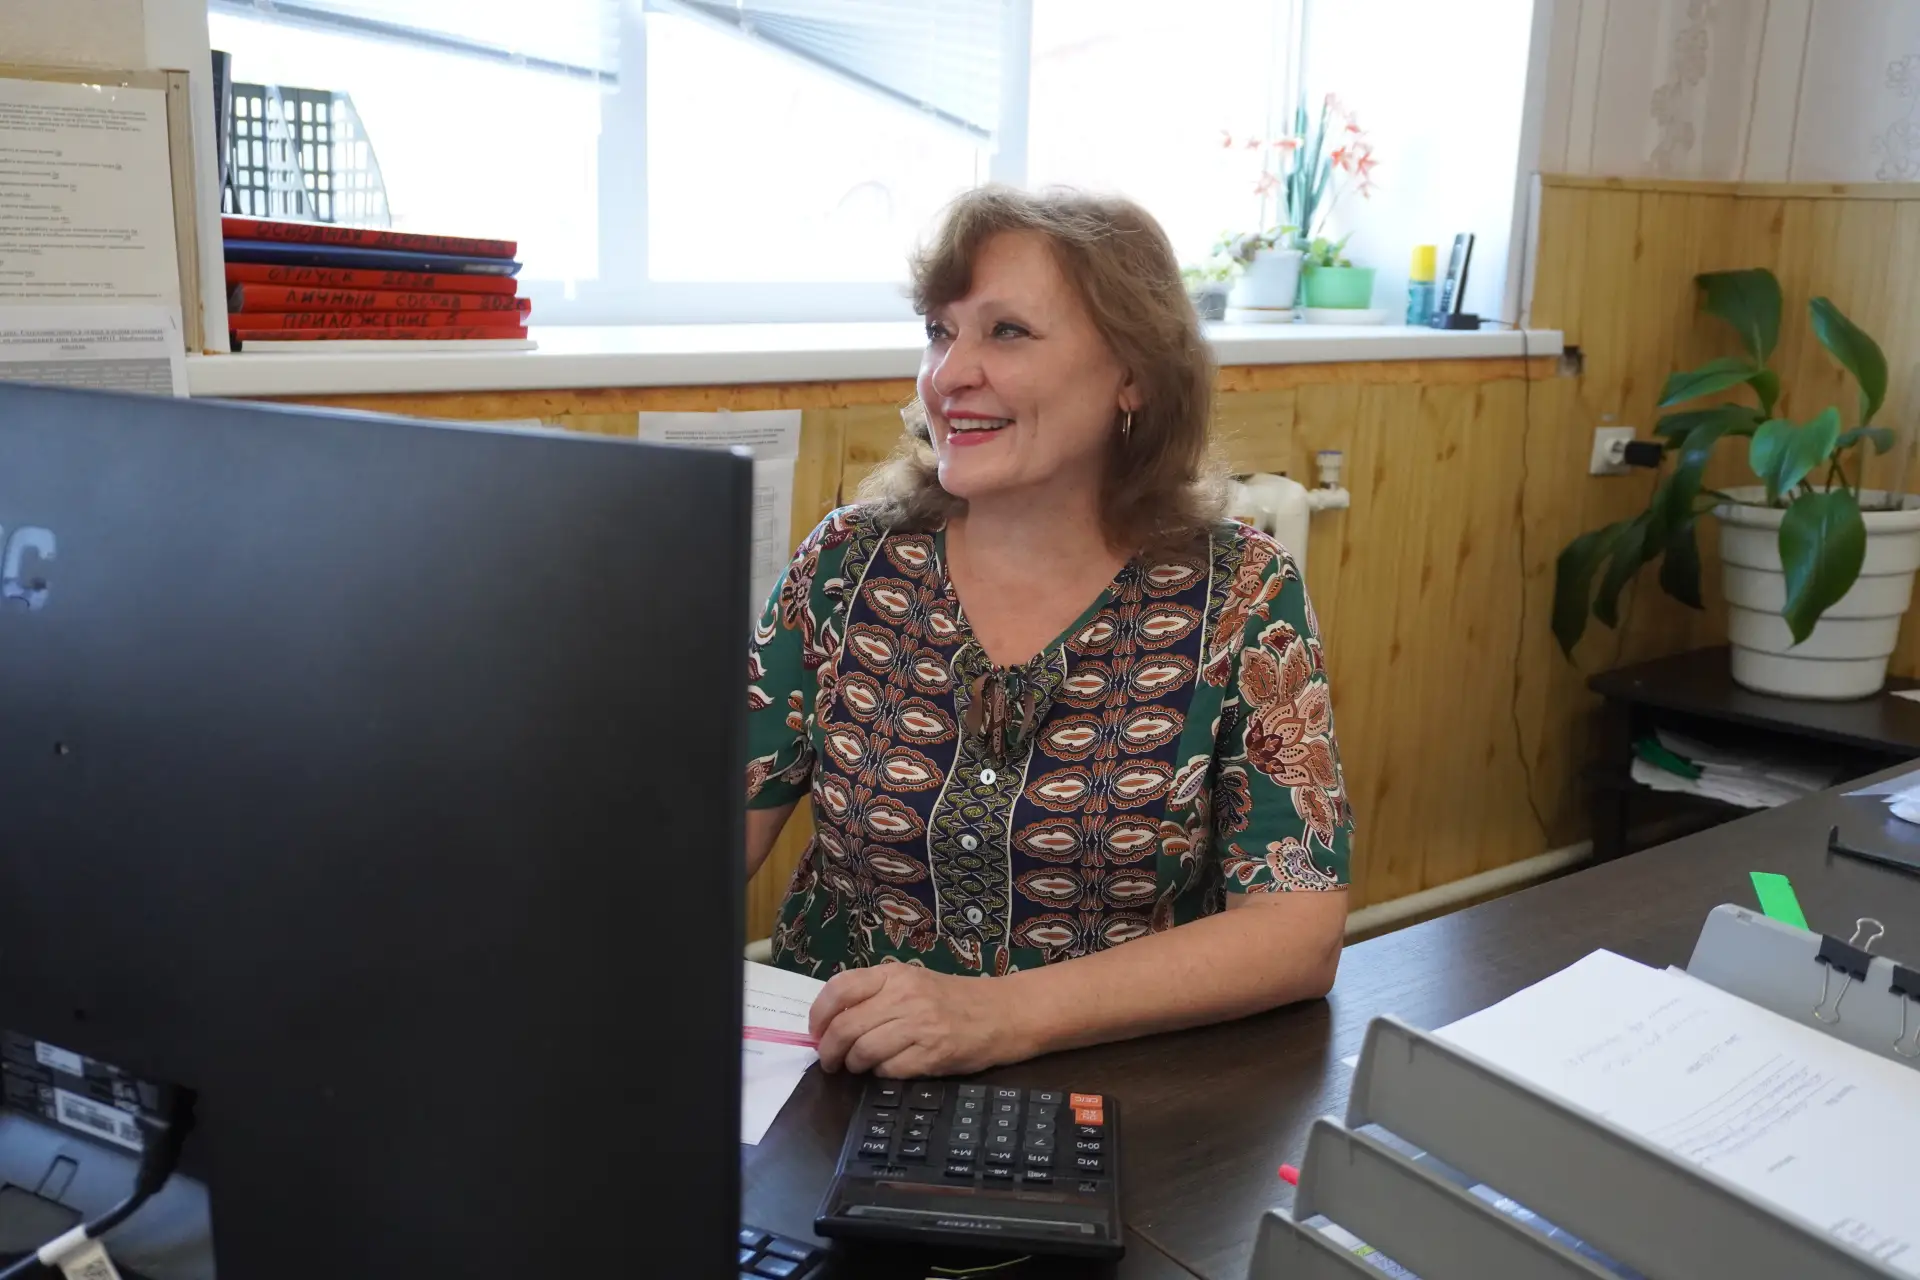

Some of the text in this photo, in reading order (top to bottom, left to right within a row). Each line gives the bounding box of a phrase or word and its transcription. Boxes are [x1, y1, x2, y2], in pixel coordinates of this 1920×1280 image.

[268, 268, 354, 282] ОТПУСК
[282, 312, 430, 328] ПРИЛОЖЕНИЕ
[863, 1142, 885, 1150] MU
